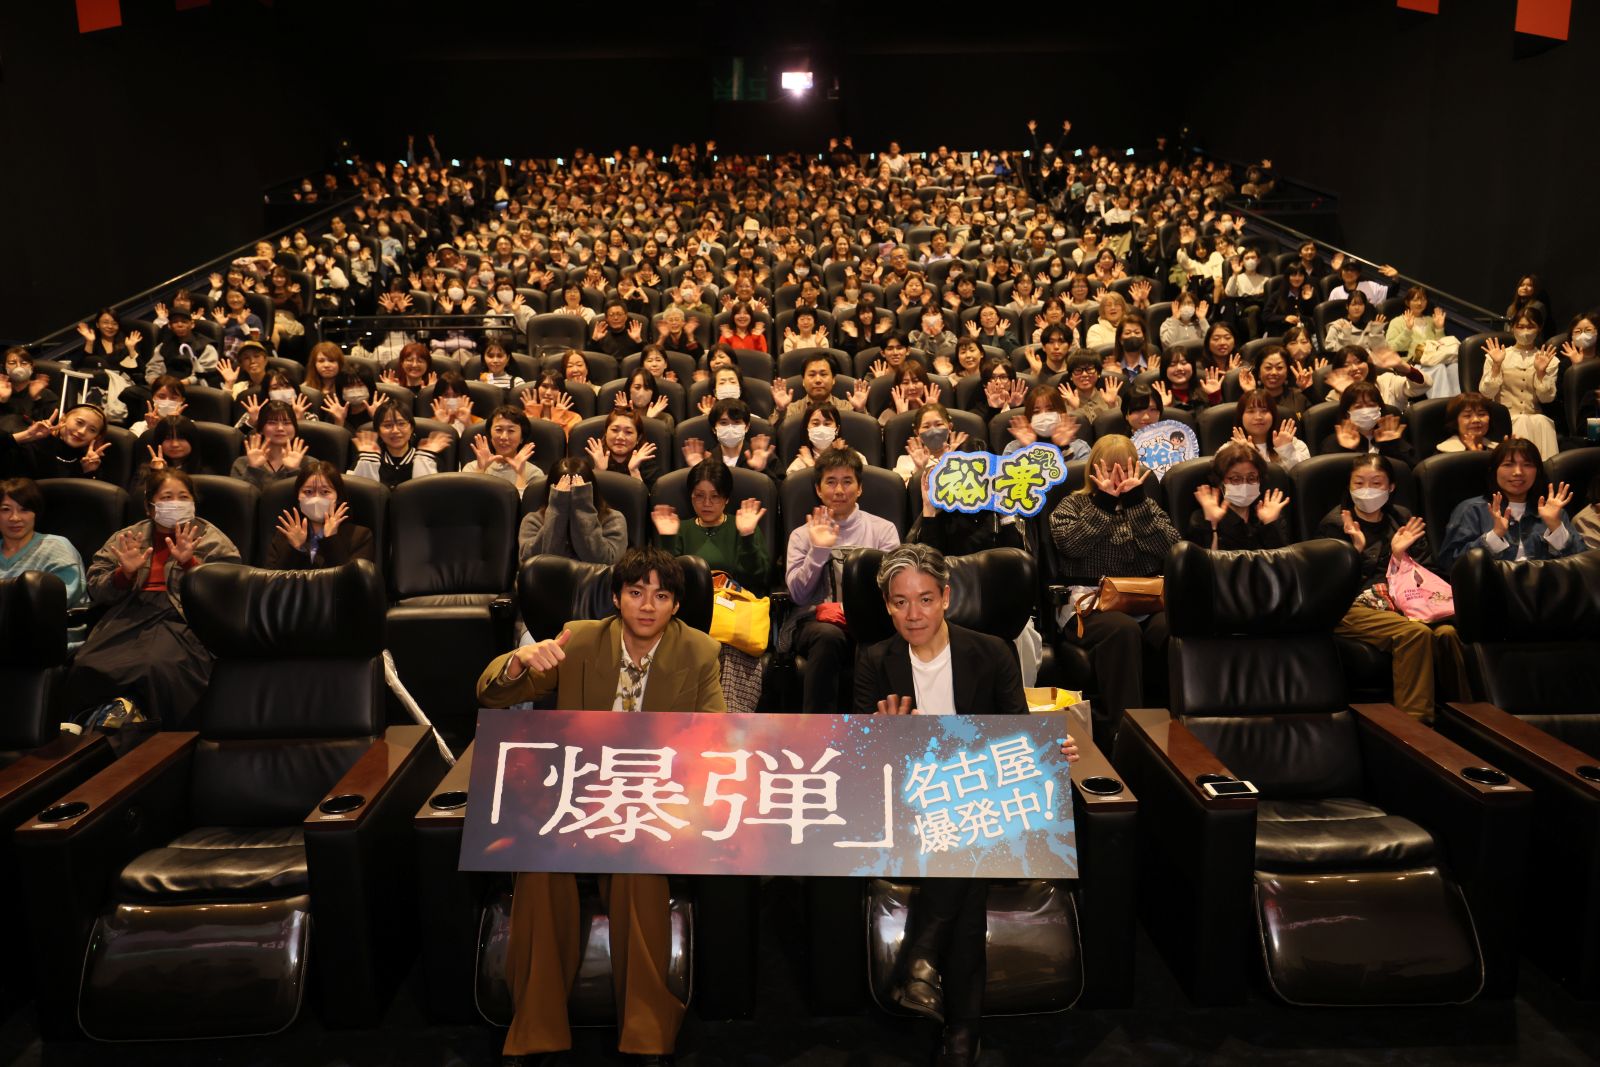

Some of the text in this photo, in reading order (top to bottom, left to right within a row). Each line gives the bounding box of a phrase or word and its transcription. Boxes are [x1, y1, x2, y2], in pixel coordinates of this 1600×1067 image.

[936, 455, 1045, 511] 裕貴
[490, 741, 895, 848] 「爆弾」
[904, 735, 1043, 809] 名古屋
[913, 779, 1055, 856] 爆発中!
